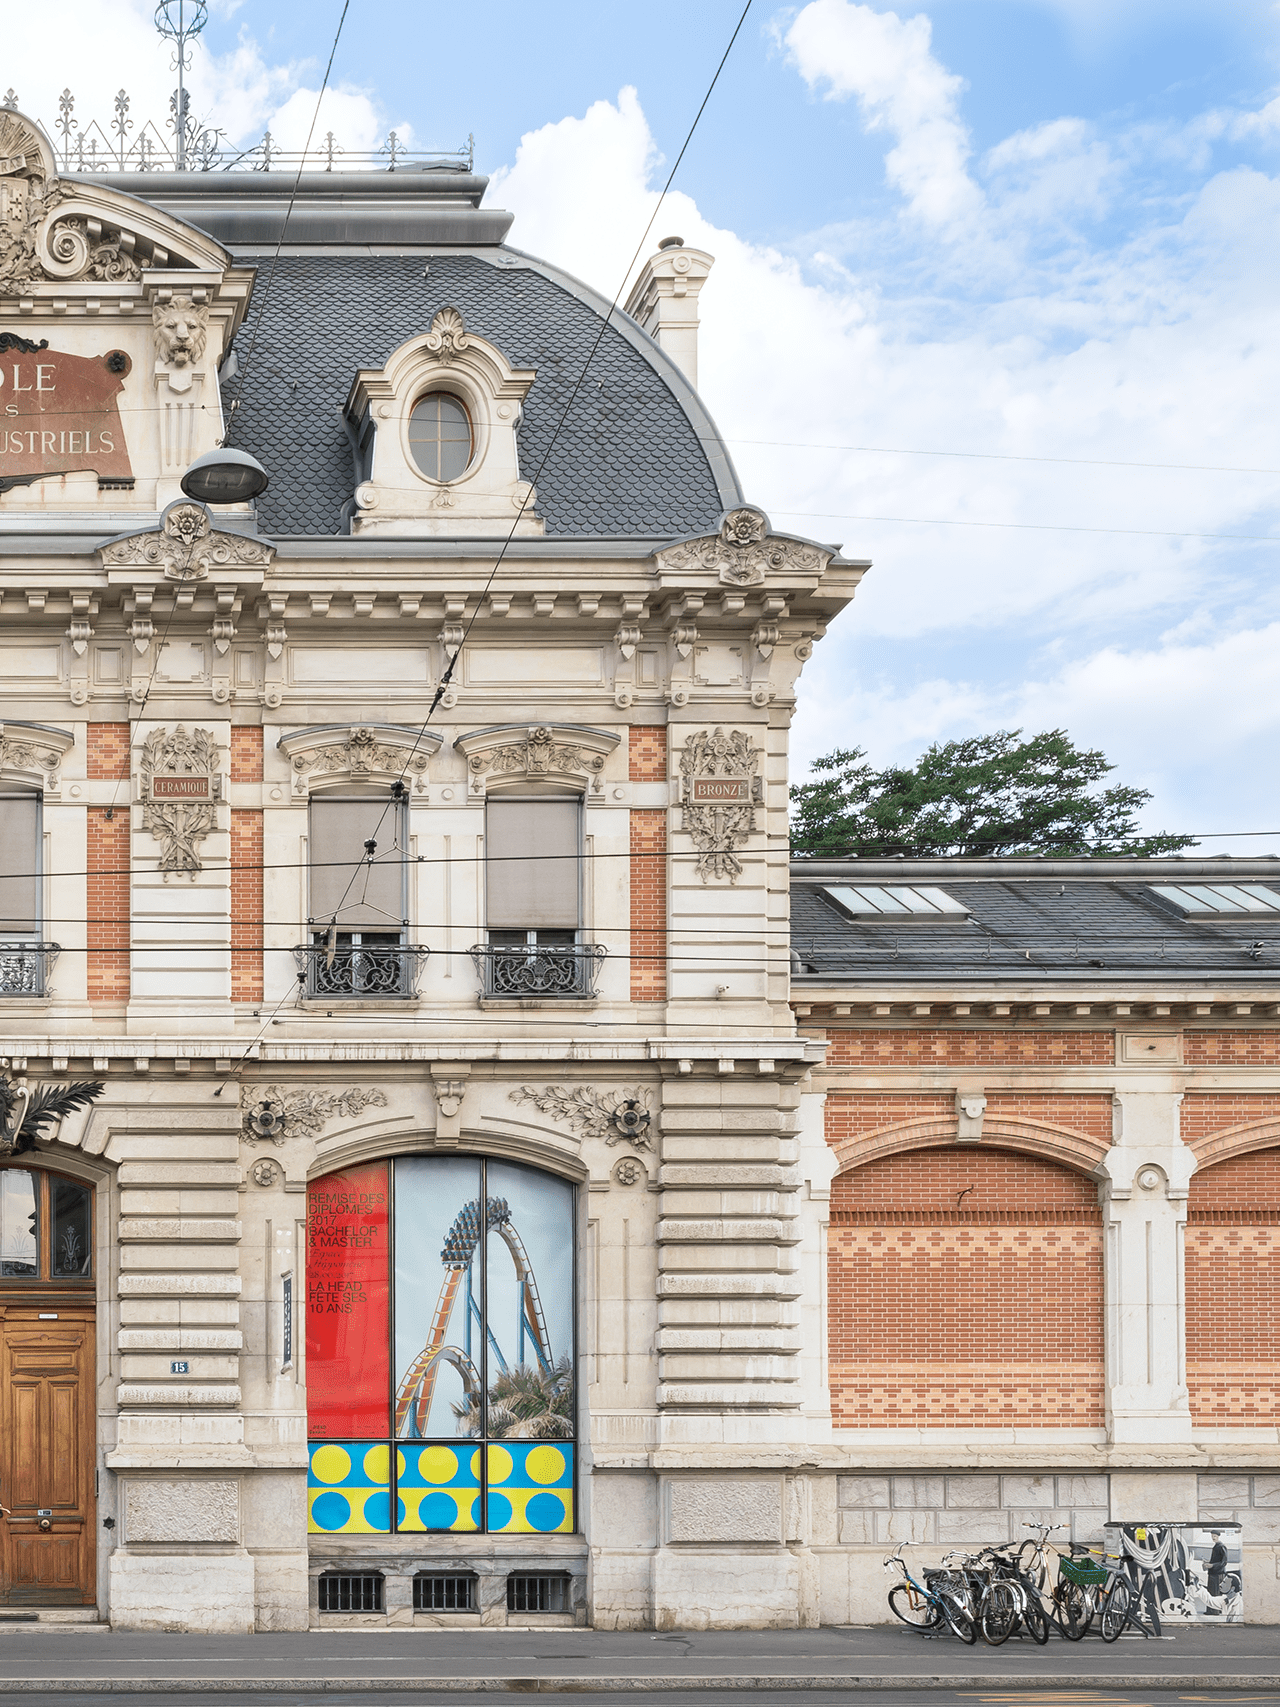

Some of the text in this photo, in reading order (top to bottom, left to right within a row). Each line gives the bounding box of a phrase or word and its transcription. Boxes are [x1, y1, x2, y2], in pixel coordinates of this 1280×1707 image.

[154, 781, 207, 793] CERAMIQUE
[698, 784, 745, 796] BRONZE
[308, 1192, 385, 1204] REMISE DES
[308, 1215, 337, 1225] 2017
[308, 1225, 378, 1236] BACHELOR
[308, 1236, 372, 1247] & MASTER
[308, 1281, 363, 1292] LA HEAD
[309, 1290, 367, 1303] FÊTE SES
[310, 1303, 353, 1314] 10 ANS
[174, 1362, 186, 1372] 15
